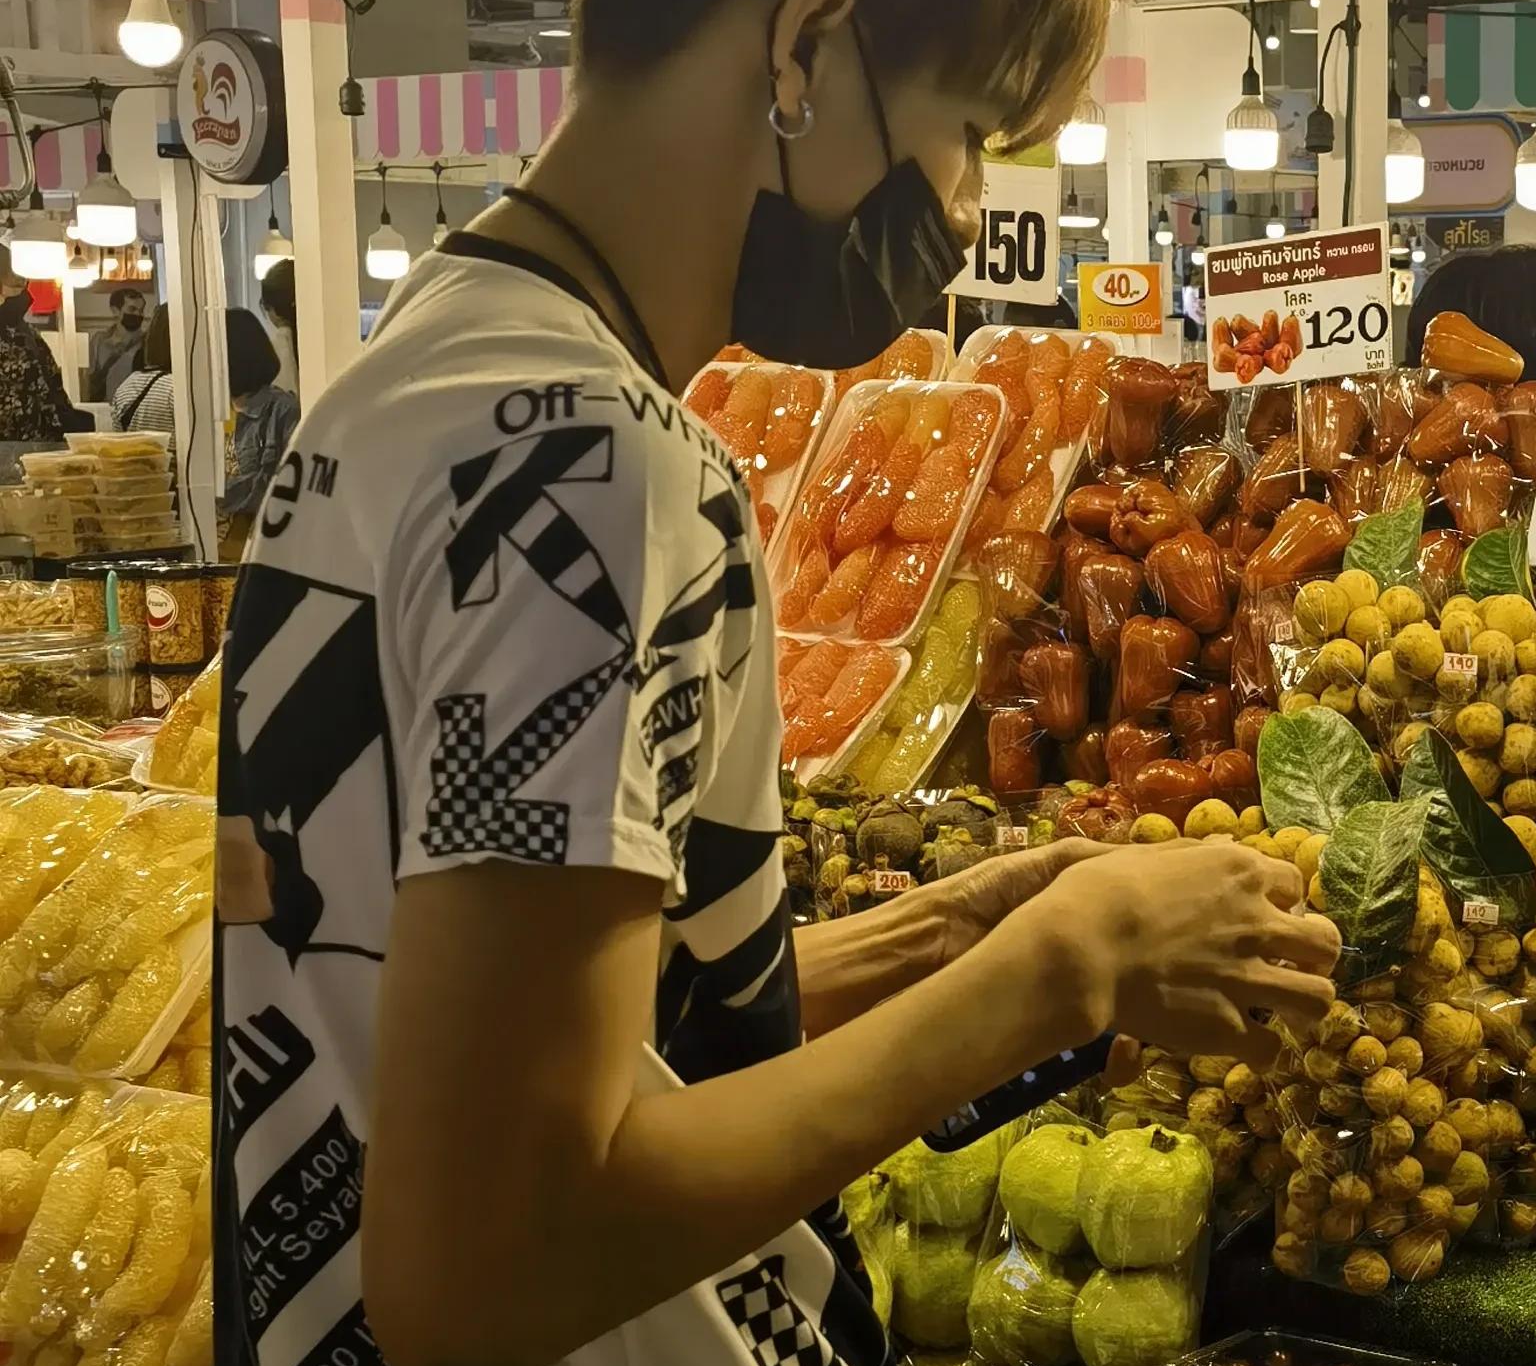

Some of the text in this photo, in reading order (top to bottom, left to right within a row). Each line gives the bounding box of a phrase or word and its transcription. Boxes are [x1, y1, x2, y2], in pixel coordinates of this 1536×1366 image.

[974, 208, 1047, 286] 150
[1211, 240, 1321, 277] ชมพู่ทับทิมจันทร์
[1350, 241, 1375, 255] กรอบ
[1262, 263, 1327, 285] Rose Apple
[1086, 314, 1095, 328] 3
[1305, 302, 1389, 350] 120
[1364, 348, 1386, 361] บาท
[1366, 361, 1385, 371] Baht
[269, 1136, 349, 1223] 5.400
